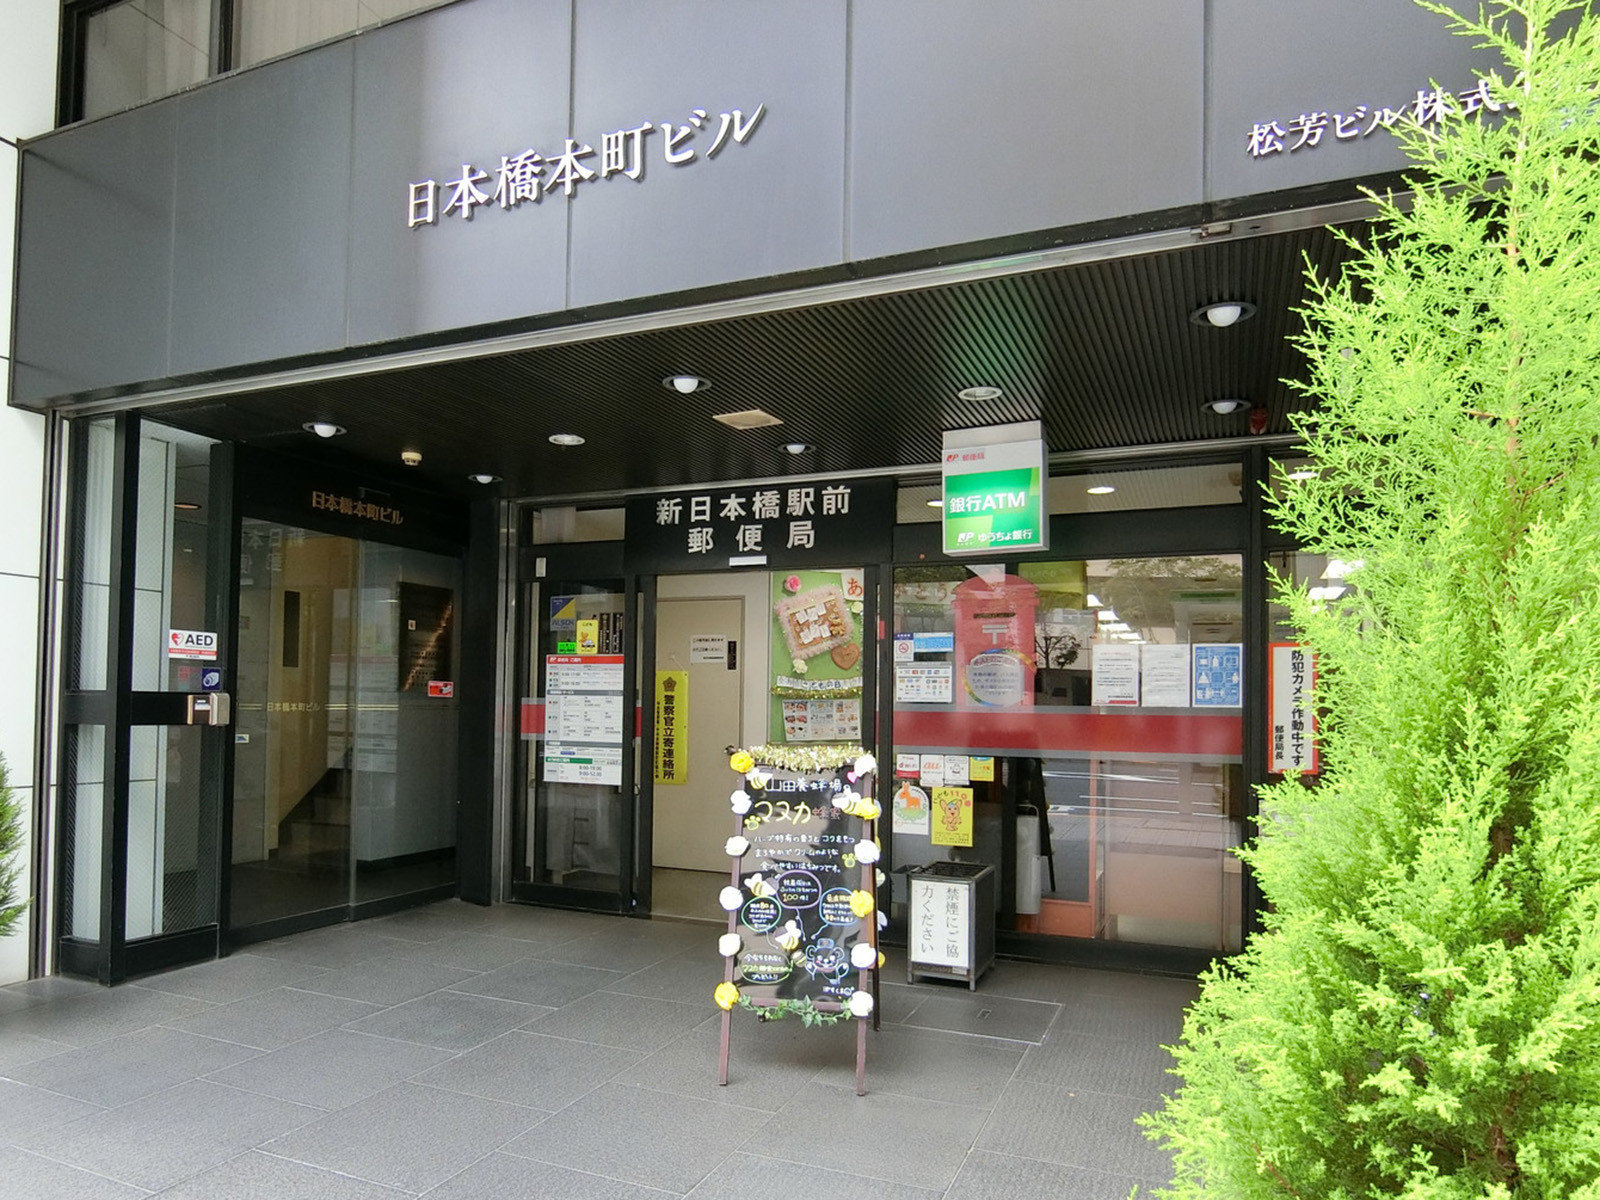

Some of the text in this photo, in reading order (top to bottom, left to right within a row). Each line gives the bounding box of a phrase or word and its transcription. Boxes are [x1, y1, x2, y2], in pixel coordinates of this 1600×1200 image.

[1246, 78, 1518, 158] 松芳ビル株式
[407, 102, 765, 229] 日本橋本町ビル
[312, 490, 404, 525] 日本橋本町ビル
[655, 485, 852, 526] 新日本橋駅前
[949, 491, 1027, 514] 銀行ATM
[687, 520, 816, 554] 郵便局
[977, 529, 1033, 543] ゆうちょ銀行
[847, 578, 864, 597] あ
[185, 634, 214, 646] AED
[266, 702, 321, 712] 日本橋本町ビル
[1291, 650, 1305, 766] 防犯カメラ作動中です
[662, 694, 675, 780] 警察官立寄連絡所
[1274, 725, 1285, 760] 郵便局長
[923, 762, 942, 770] au
[921, 885, 934, 953] 力ください
